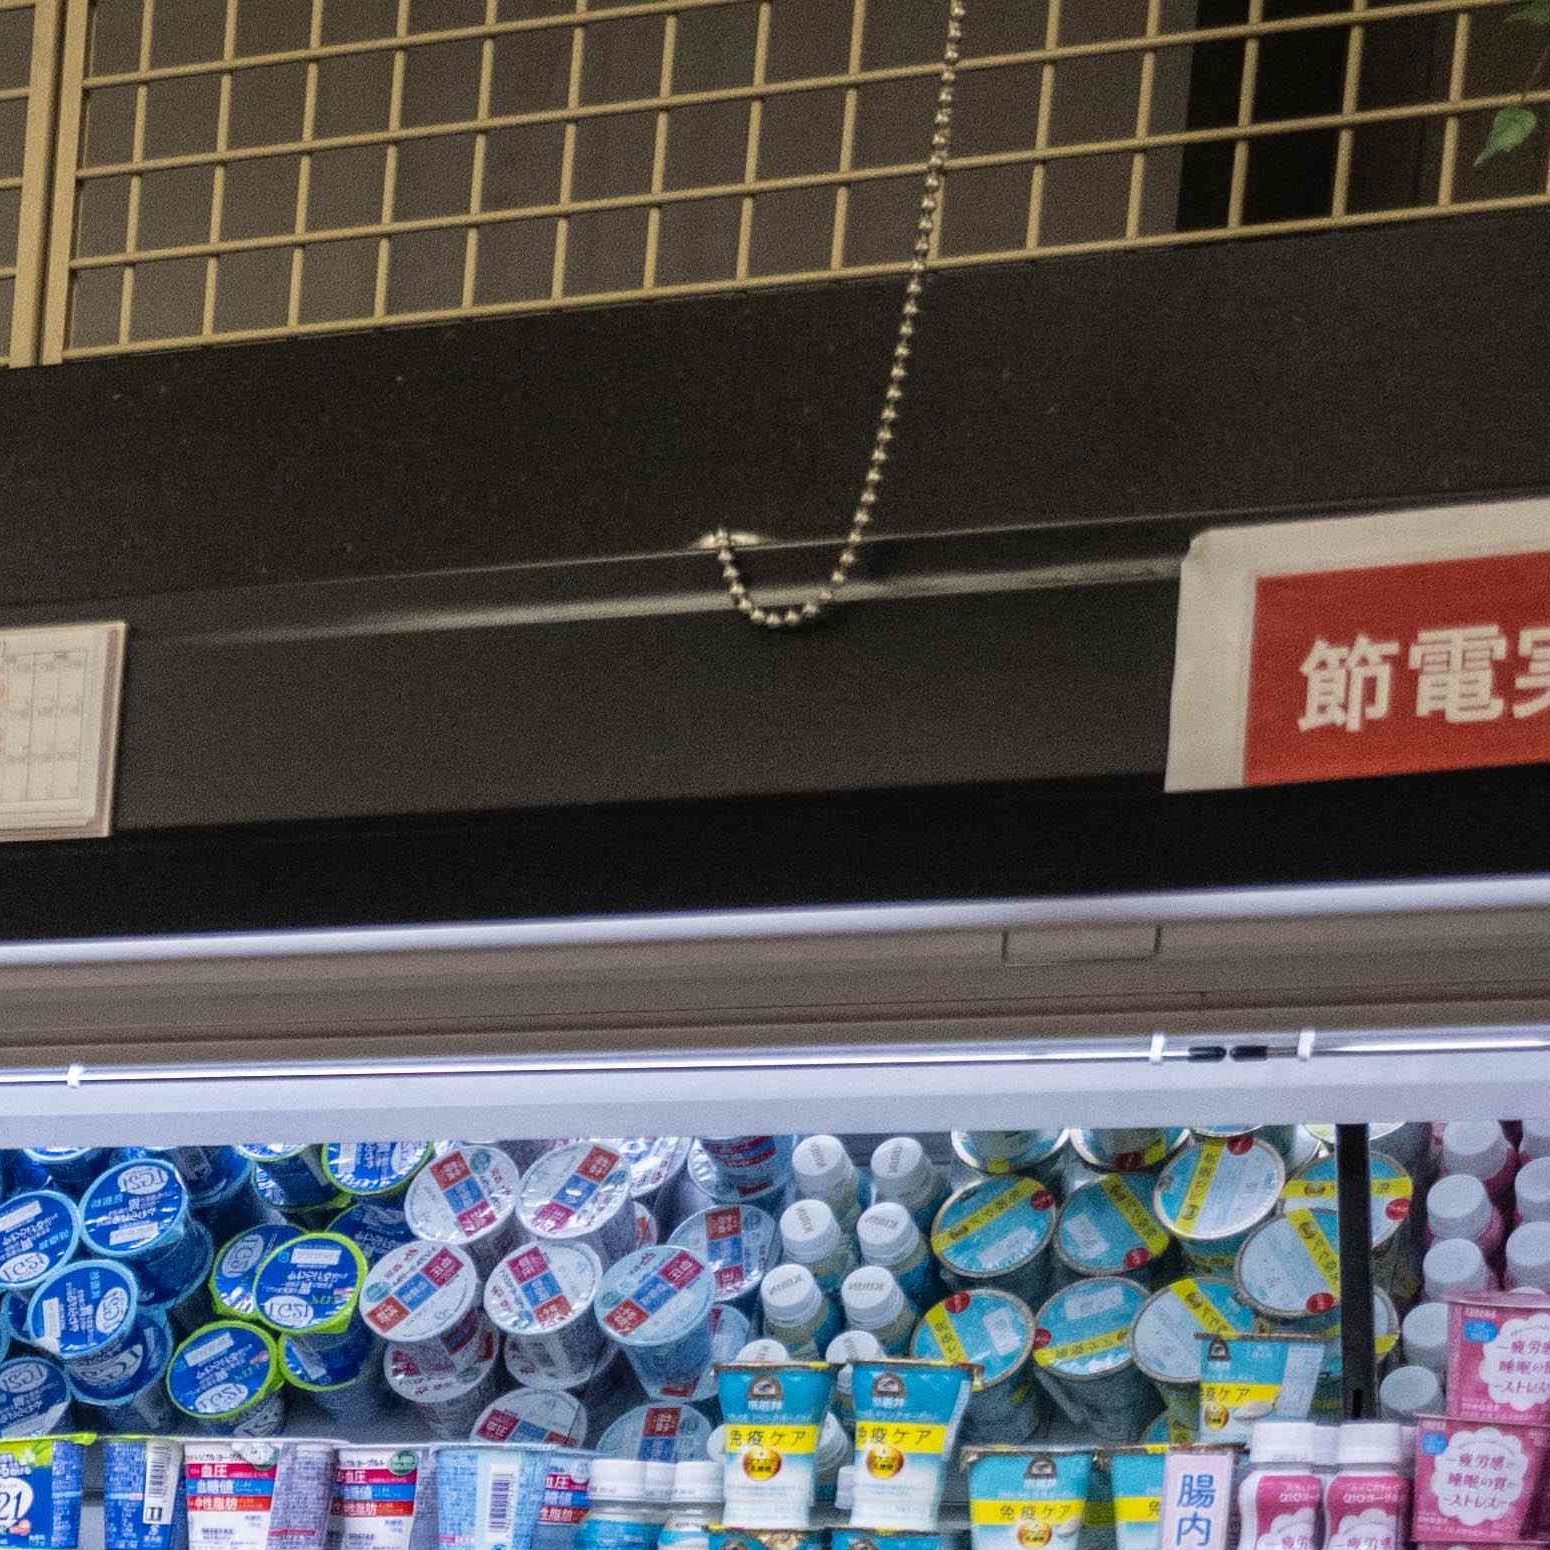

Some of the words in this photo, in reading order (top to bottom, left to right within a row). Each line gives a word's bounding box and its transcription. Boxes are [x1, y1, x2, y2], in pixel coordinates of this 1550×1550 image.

[727, 1426, 819, 1452] 免疫ケア
[991, 1499, 1073, 1524] 免疫ケア
